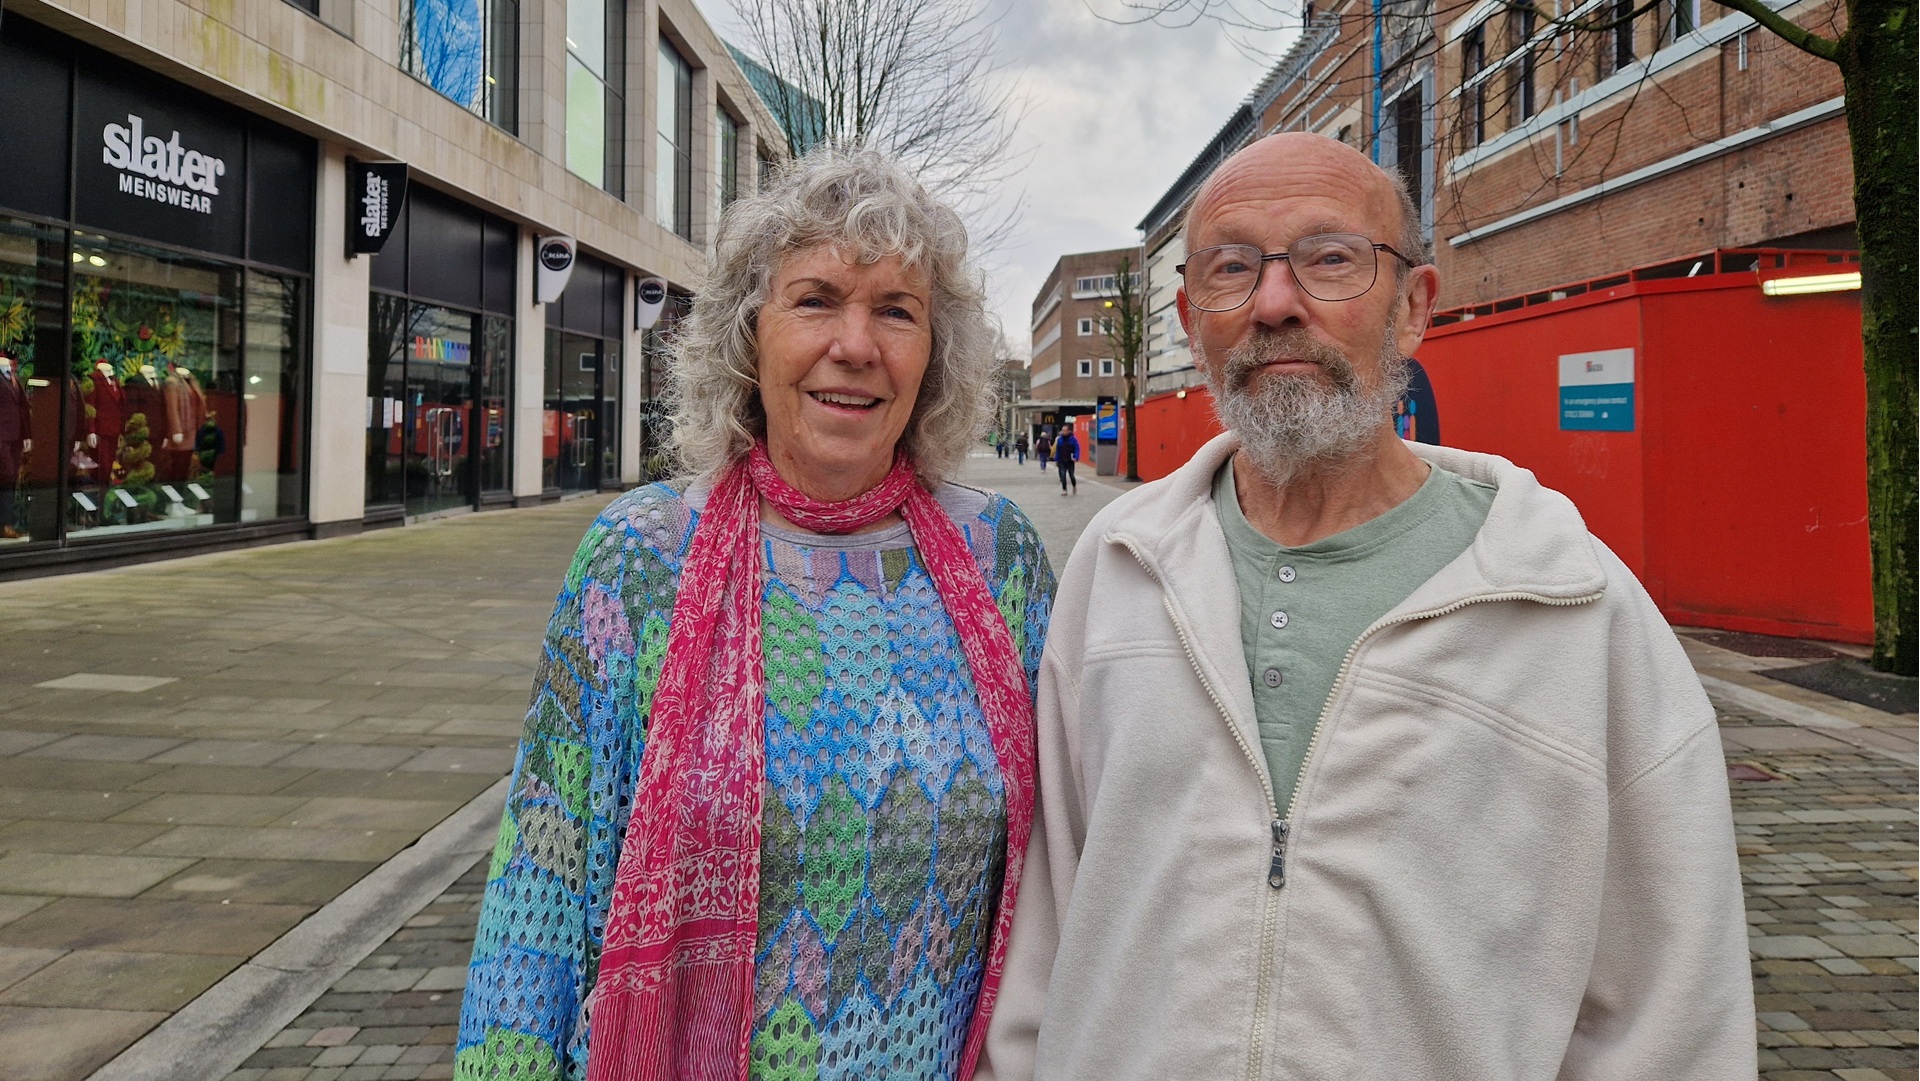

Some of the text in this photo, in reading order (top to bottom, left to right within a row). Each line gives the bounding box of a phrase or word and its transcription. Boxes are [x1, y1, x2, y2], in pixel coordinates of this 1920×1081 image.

[103, 114, 225, 195] slater
[118, 172, 212, 214] MENSWEAR
[361, 171, 381, 237] slater
[380, 179, 388, 230] MENSWEAR
